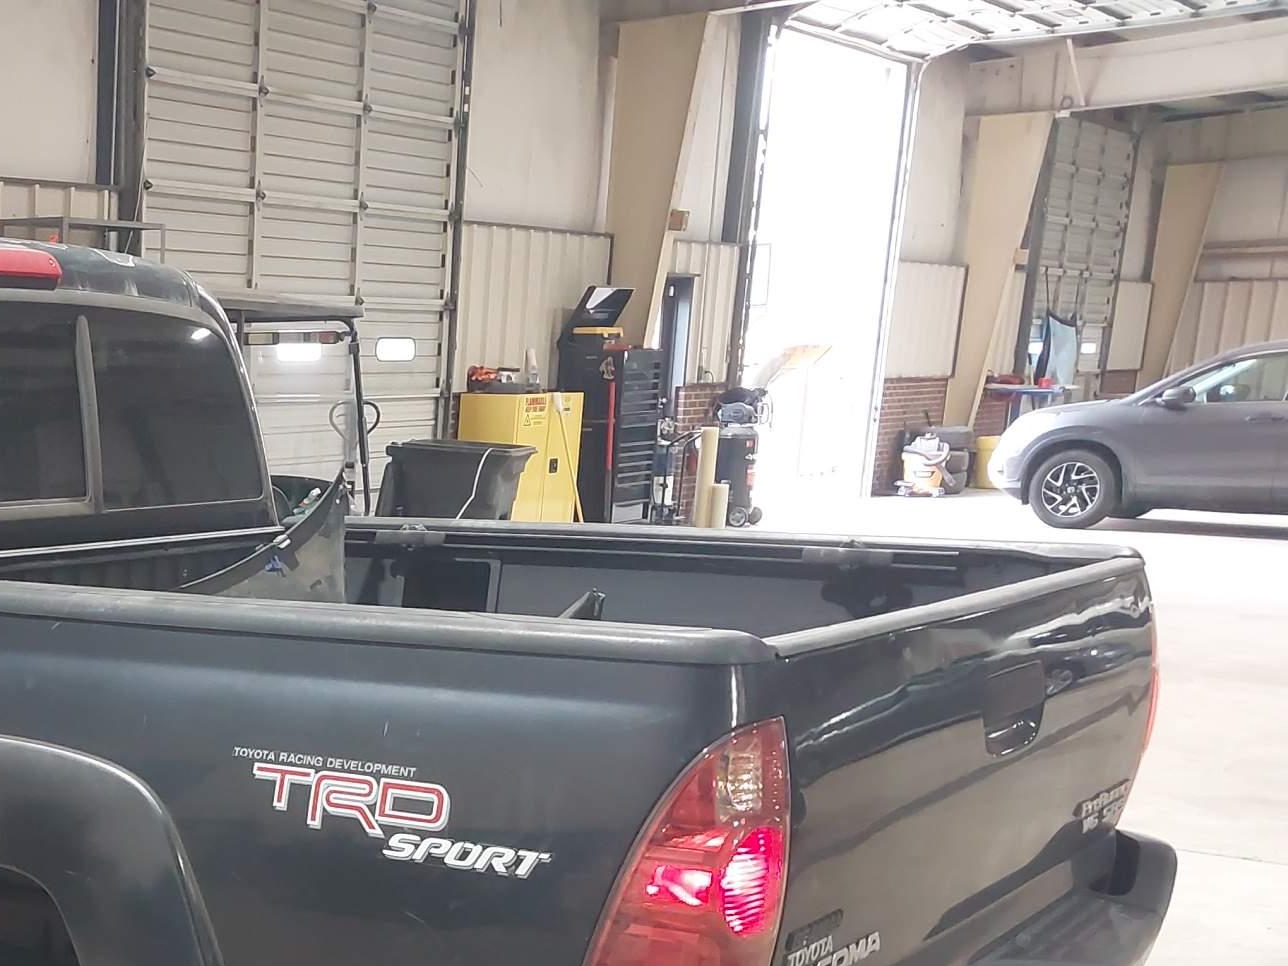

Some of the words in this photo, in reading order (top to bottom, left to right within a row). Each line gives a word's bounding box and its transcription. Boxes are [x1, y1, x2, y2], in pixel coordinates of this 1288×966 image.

[233, 747, 275, 761] TOYOTA
[278, 752, 323, 767] RACING
[326, 757, 417, 778] DEVELOPMENT
[252, 762, 452, 839] TRD
[382, 833, 553, 879] SPORT
